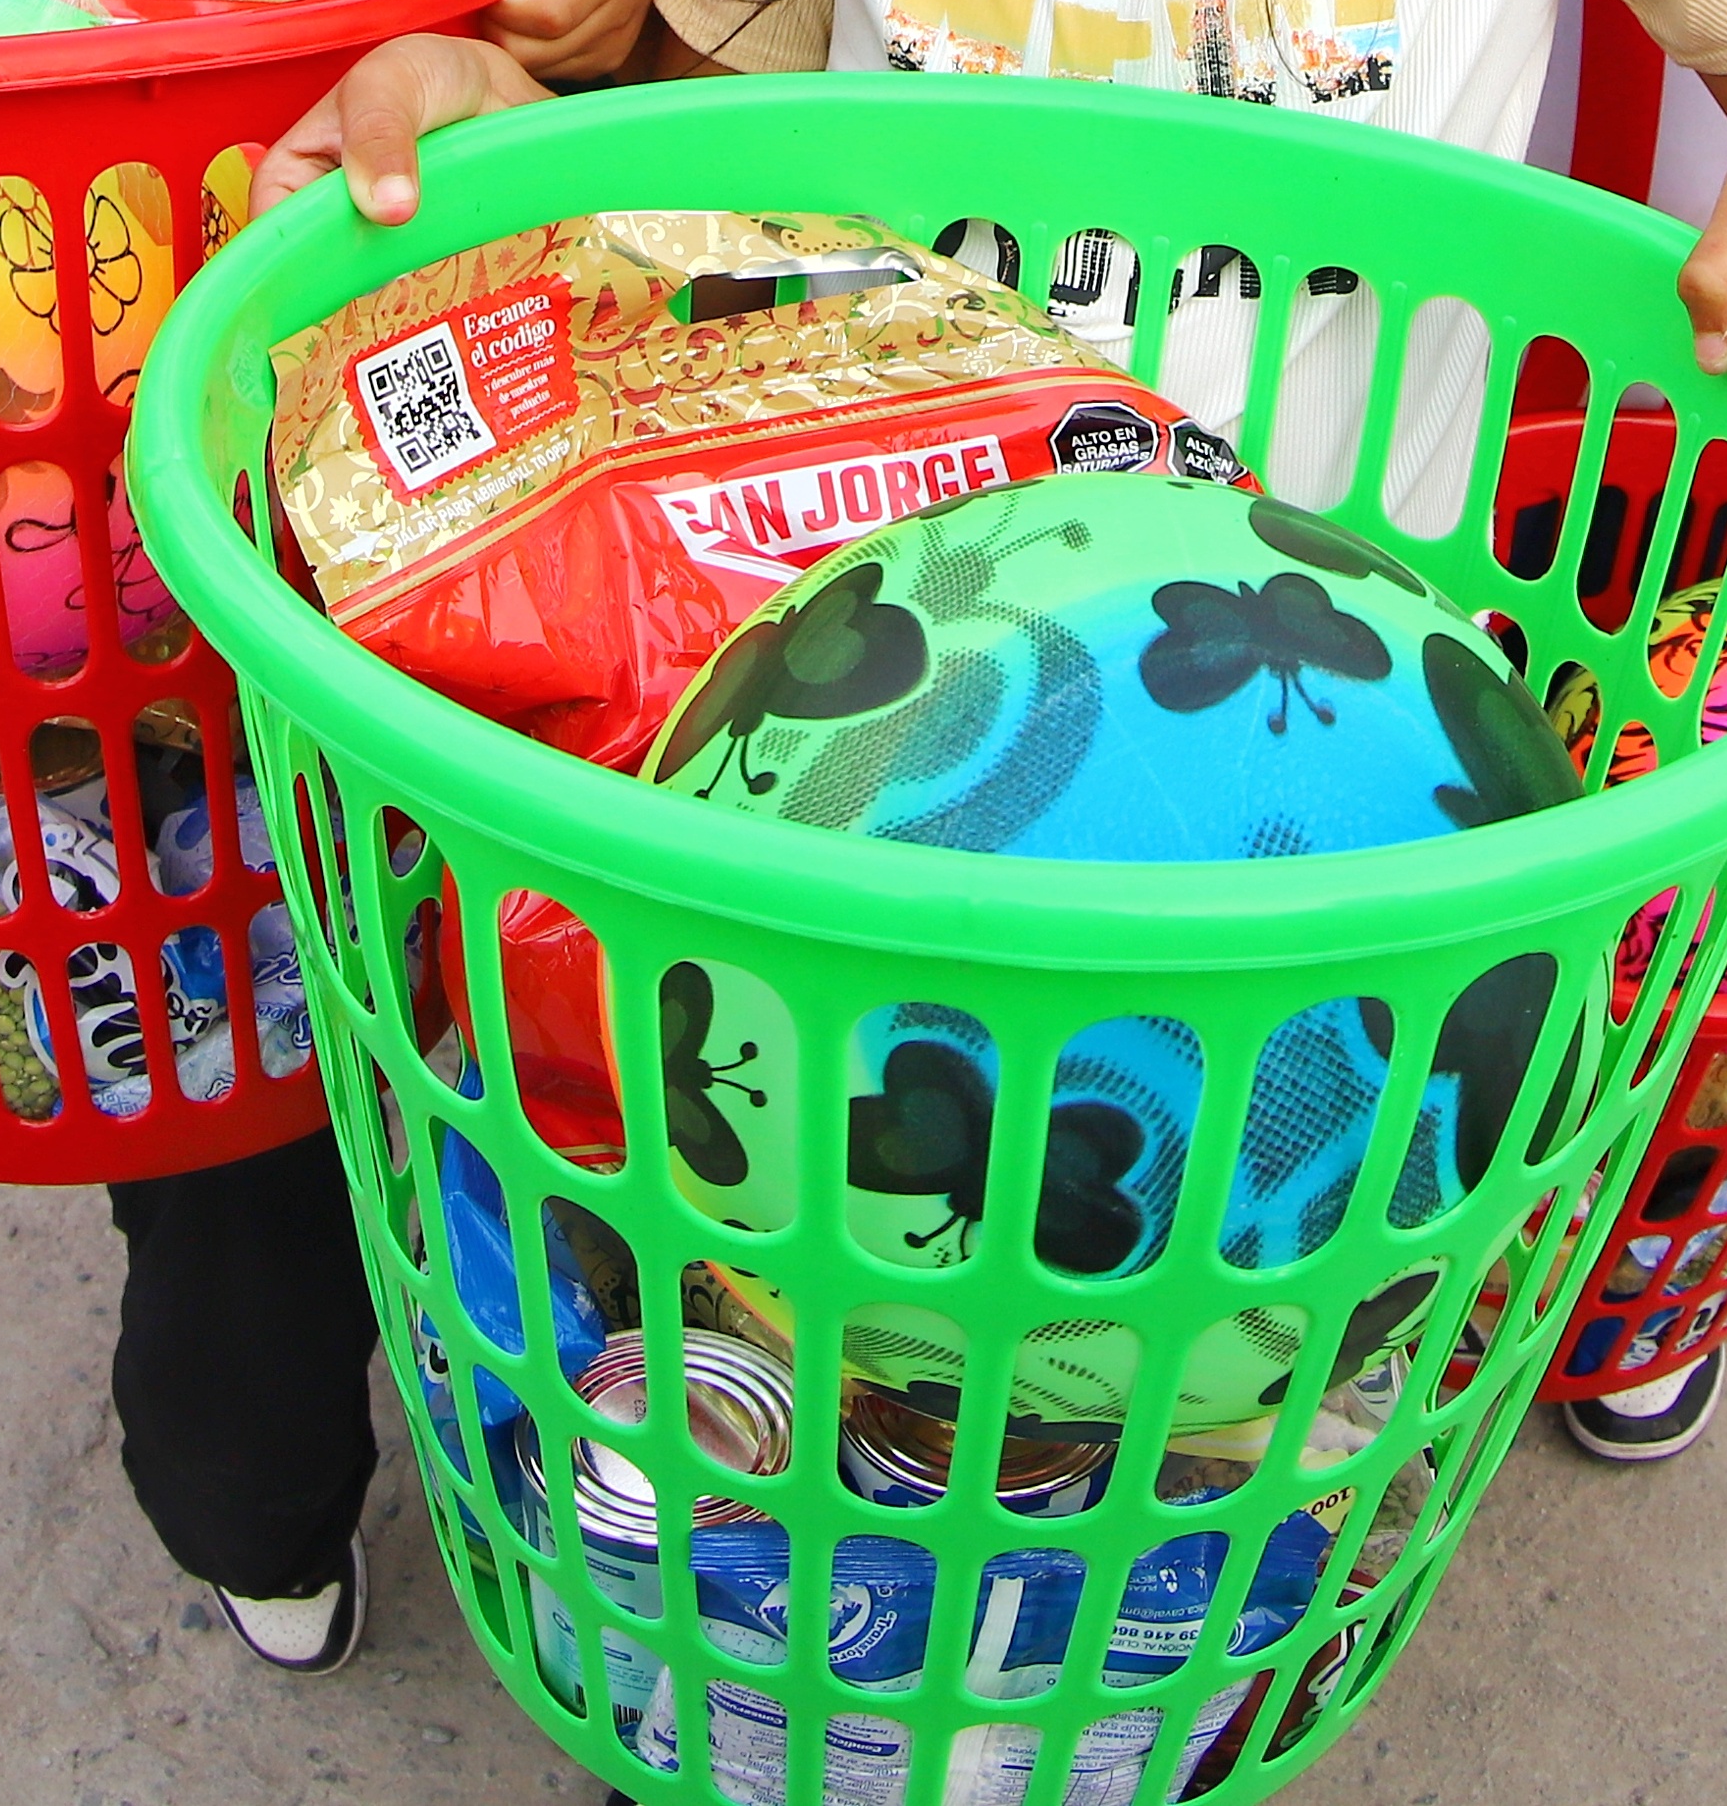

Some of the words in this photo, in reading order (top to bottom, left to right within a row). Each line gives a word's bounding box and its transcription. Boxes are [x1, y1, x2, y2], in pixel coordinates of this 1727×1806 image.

[462, 293, 552, 340] Escanea
[470, 341, 488, 368] el
[488, 318, 556, 360] código
[484, 384, 493, 397] y
[490, 362, 532, 391] descubre
[498, 391, 510, 405] de
[509, 372, 549, 400] nuestros
[510, 390, 551, 420] productos
[1072, 429, 1111, 449] ALTO
[1114, 425, 1138, 442] EN
[1075, 440, 1140, 462] GRASAS
[1062, 450, 1152, 475] SATURADAS
[394, 512, 442, 548] JALAR
[437, 494, 476, 529] PARA
[530, 453, 549, 472] TO
[545, 437, 571, 462] OPEN
[802, 444, 995, 532] JORGE
[1142, 1642, 1157, 1651] AL
[1143, 1630, 1175, 1641] 416
